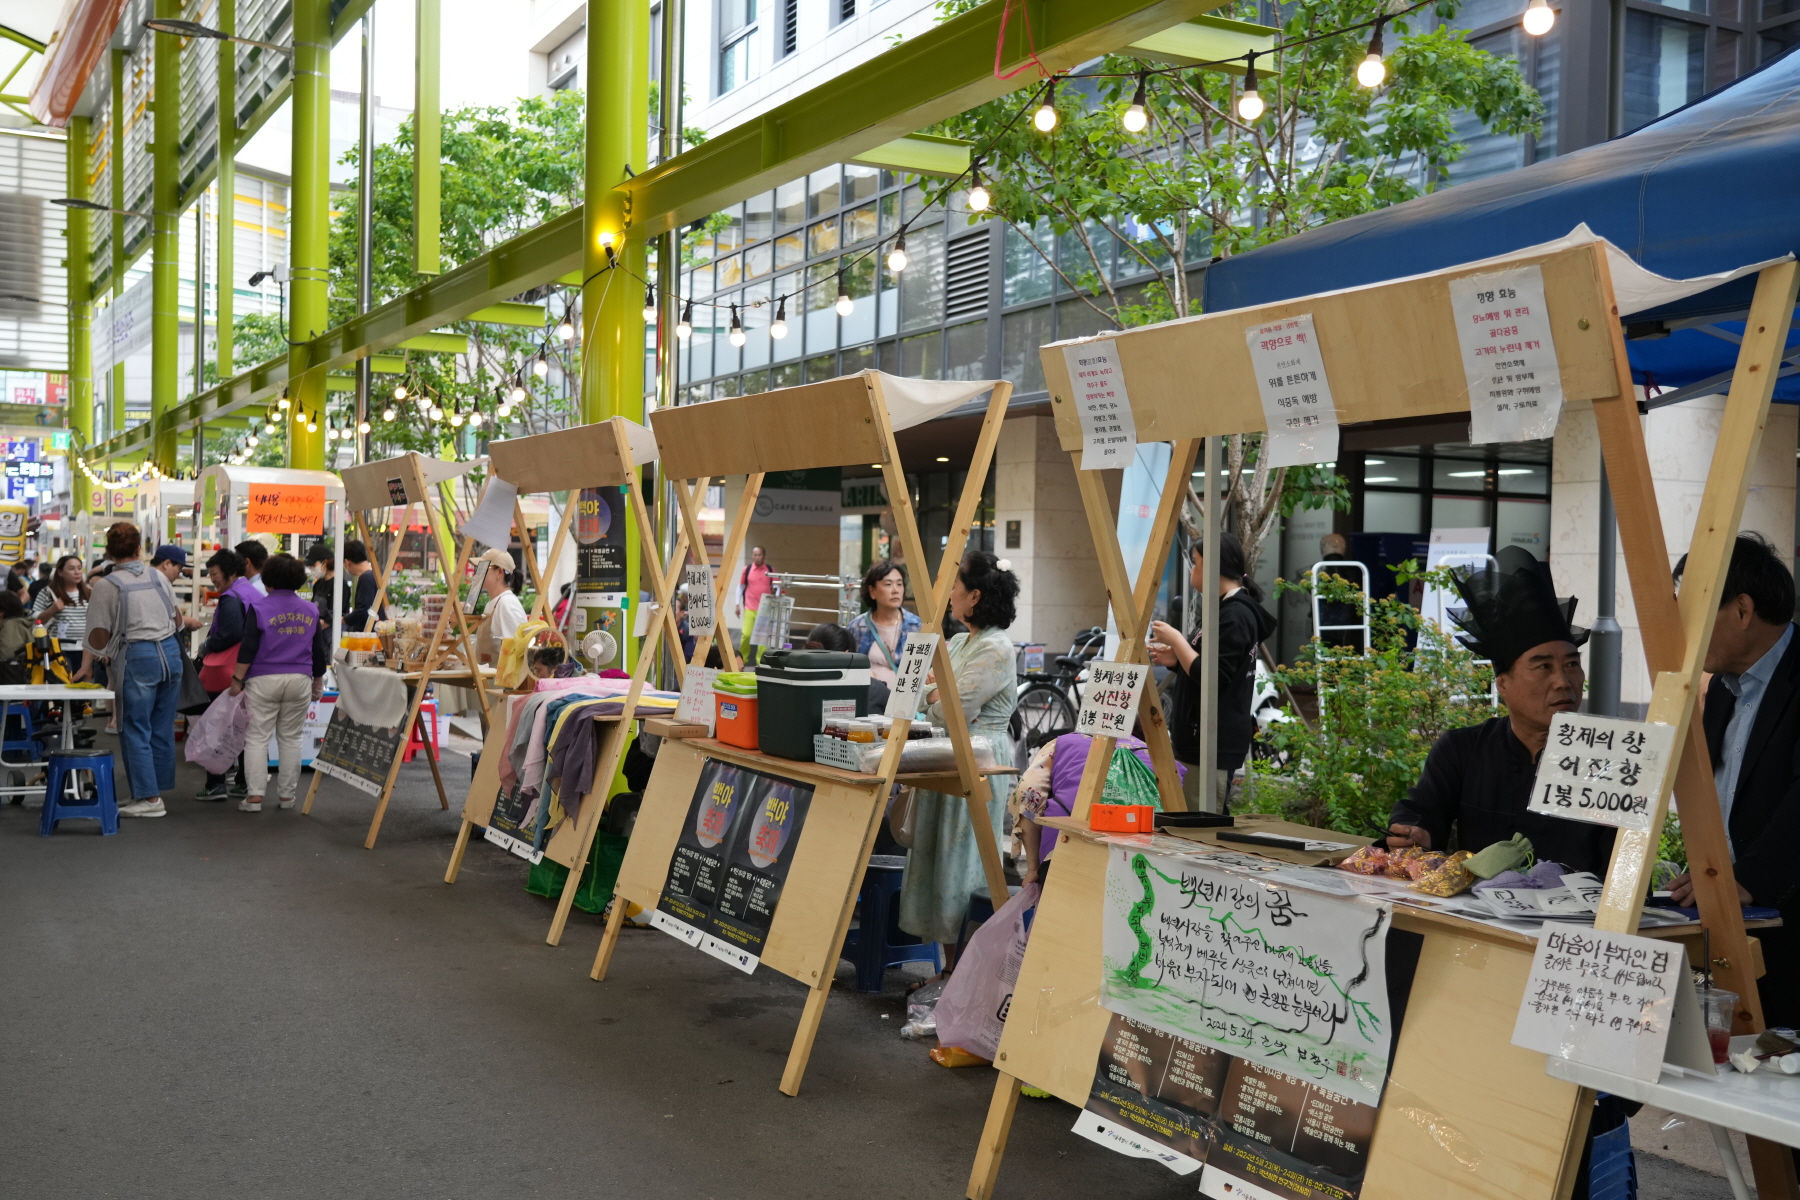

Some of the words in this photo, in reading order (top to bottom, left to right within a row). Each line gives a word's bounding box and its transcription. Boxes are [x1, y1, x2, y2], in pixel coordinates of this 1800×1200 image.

[1477, 291, 1494, 304] 정향
[1499, 288, 1516, 299] 효능
[1472, 312, 1500, 323] 당뇨예방
[1504, 310, 1512, 318] 및
[1514, 307, 1529, 316] 관리
[1489, 326, 1518, 338] 골다공증
[1261, 336, 1292, 351] 곽향으로
[1475, 346, 1496, 356] 고기의
[1500, 343, 1521, 353] 누린내
[1525, 340, 1540, 349] 제거
[1495, 360, 1525, 369] 천연소화제
[1269, 377, 1284, 388] 위를
[1287, 371, 1317, 386] 튼튼하게
[1278, 396, 1299, 408] 식중독
[1302, 393, 1317, 404] 예방
[268, 612, 314, 627] 주민자치회
[277, 626, 305, 635] 수유3동
[1094, 668, 1124, 685] 황제의
[1126, 671, 1138, 688] 향
[1093, 690, 1131, 710] 어진향
[1557, 723, 1614, 750] 황제의
[1622, 730, 1646, 754] 향
[713, 781, 734, 808] 백야
[1542, 784, 1572, 808] 1봉
[1579, 788, 1648, 816] 5,000원
[766, 797, 789, 825] 백야
[703, 808, 726, 835] 축제
[755, 825, 780, 854] 축제
[1265, 889, 1308, 926] 꿈
[1547, 932, 1601, 959] 마음이
[1604, 941, 1648, 970] 부자인
[1312, 1100, 1323, 1109] EDM
[1324, 1104, 1333, 1112] DJ
[1236, 1148, 1255, 1161] 2024년
